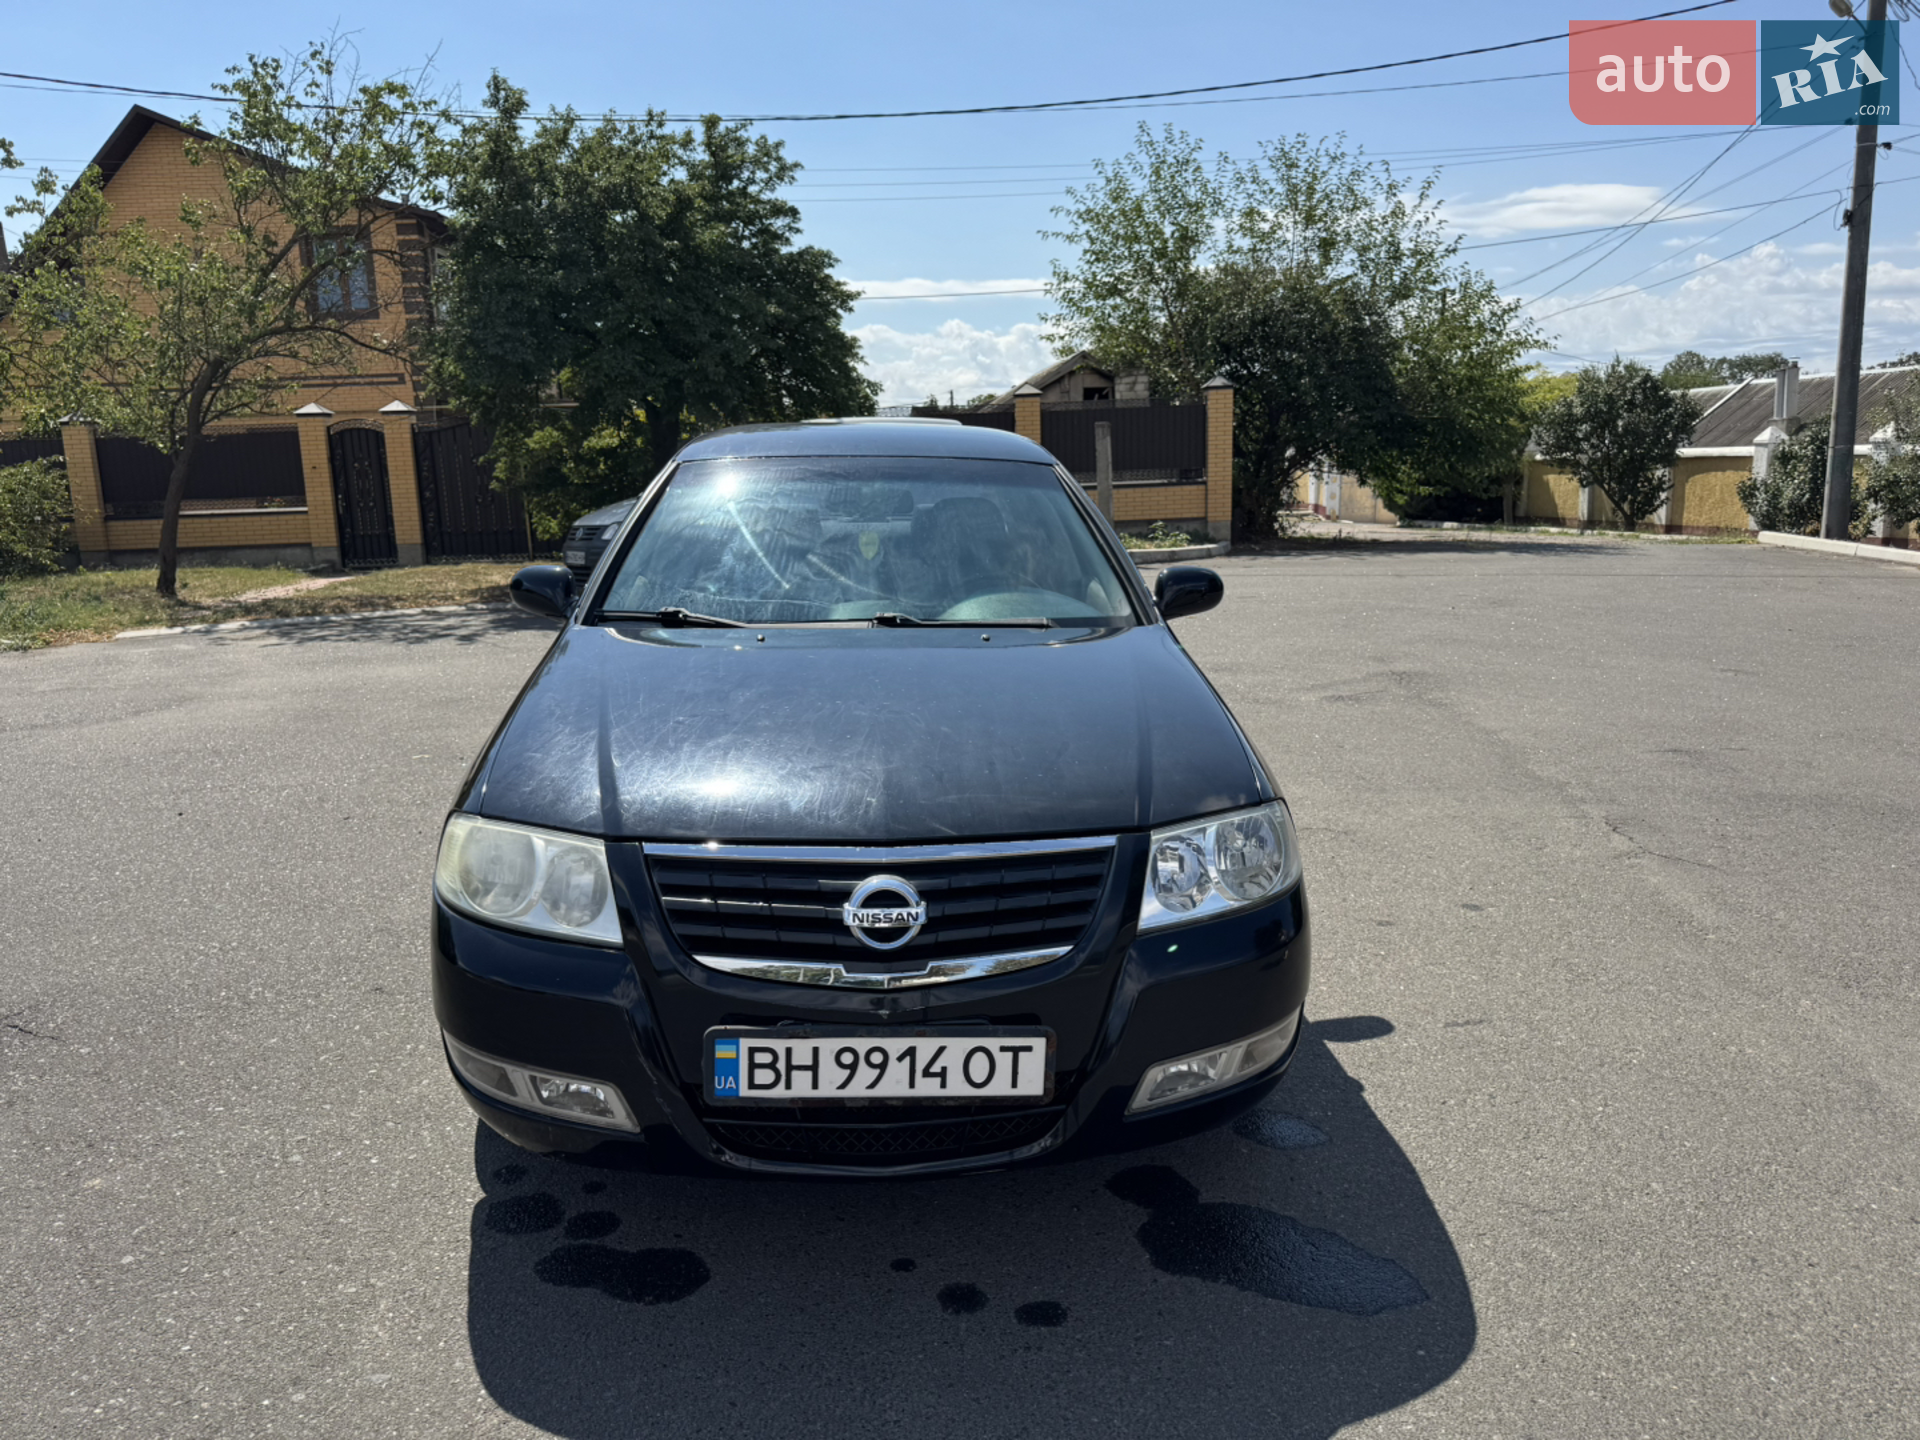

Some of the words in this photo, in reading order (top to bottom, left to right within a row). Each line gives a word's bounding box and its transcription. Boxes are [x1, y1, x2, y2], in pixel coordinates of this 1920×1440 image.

[852, 911, 919, 924] NISSAN
[747, 1046, 820, 1091] BH
[834, 1045, 948, 1090] 9914
[962, 1045, 1034, 1090] OT
[714, 1076, 737, 1090] UA
